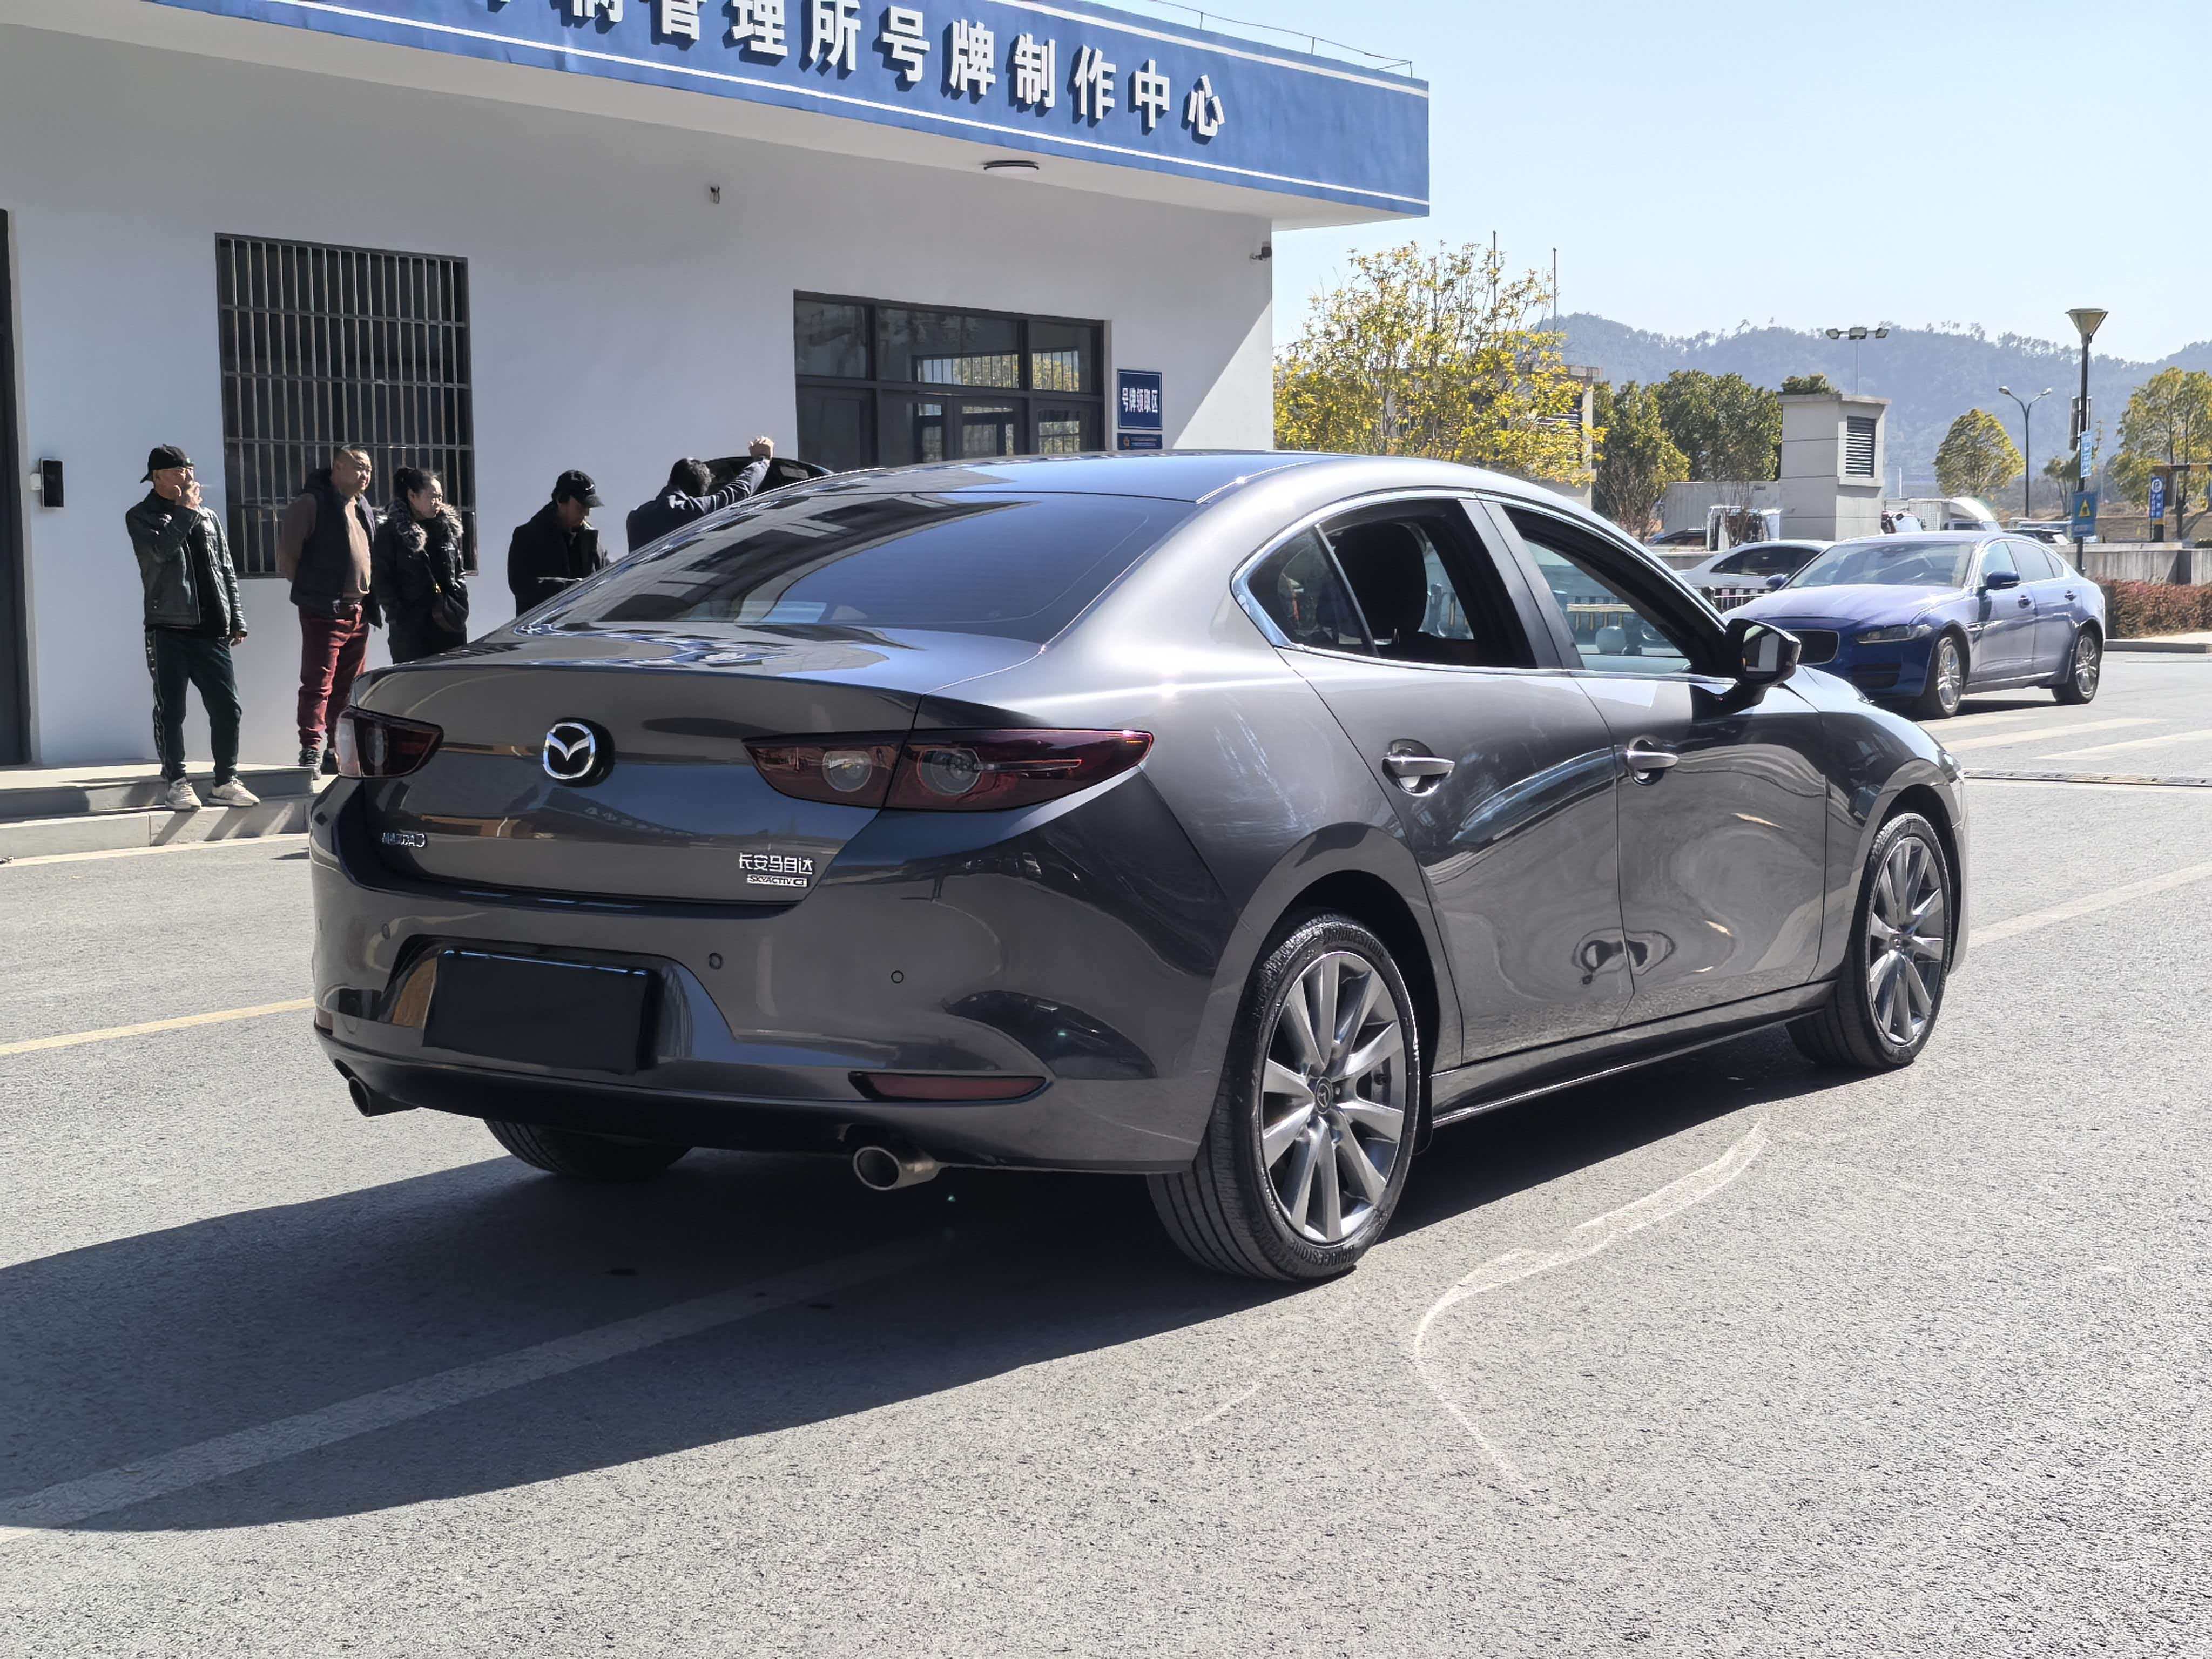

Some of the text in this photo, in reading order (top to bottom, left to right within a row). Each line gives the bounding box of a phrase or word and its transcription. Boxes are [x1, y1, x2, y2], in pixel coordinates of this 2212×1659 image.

[1122, 387, 1158, 413] 号牌领取区
[738, 852, 814, 875] 长安马自达
[749, 874, 792, 885] SKYACTIV
